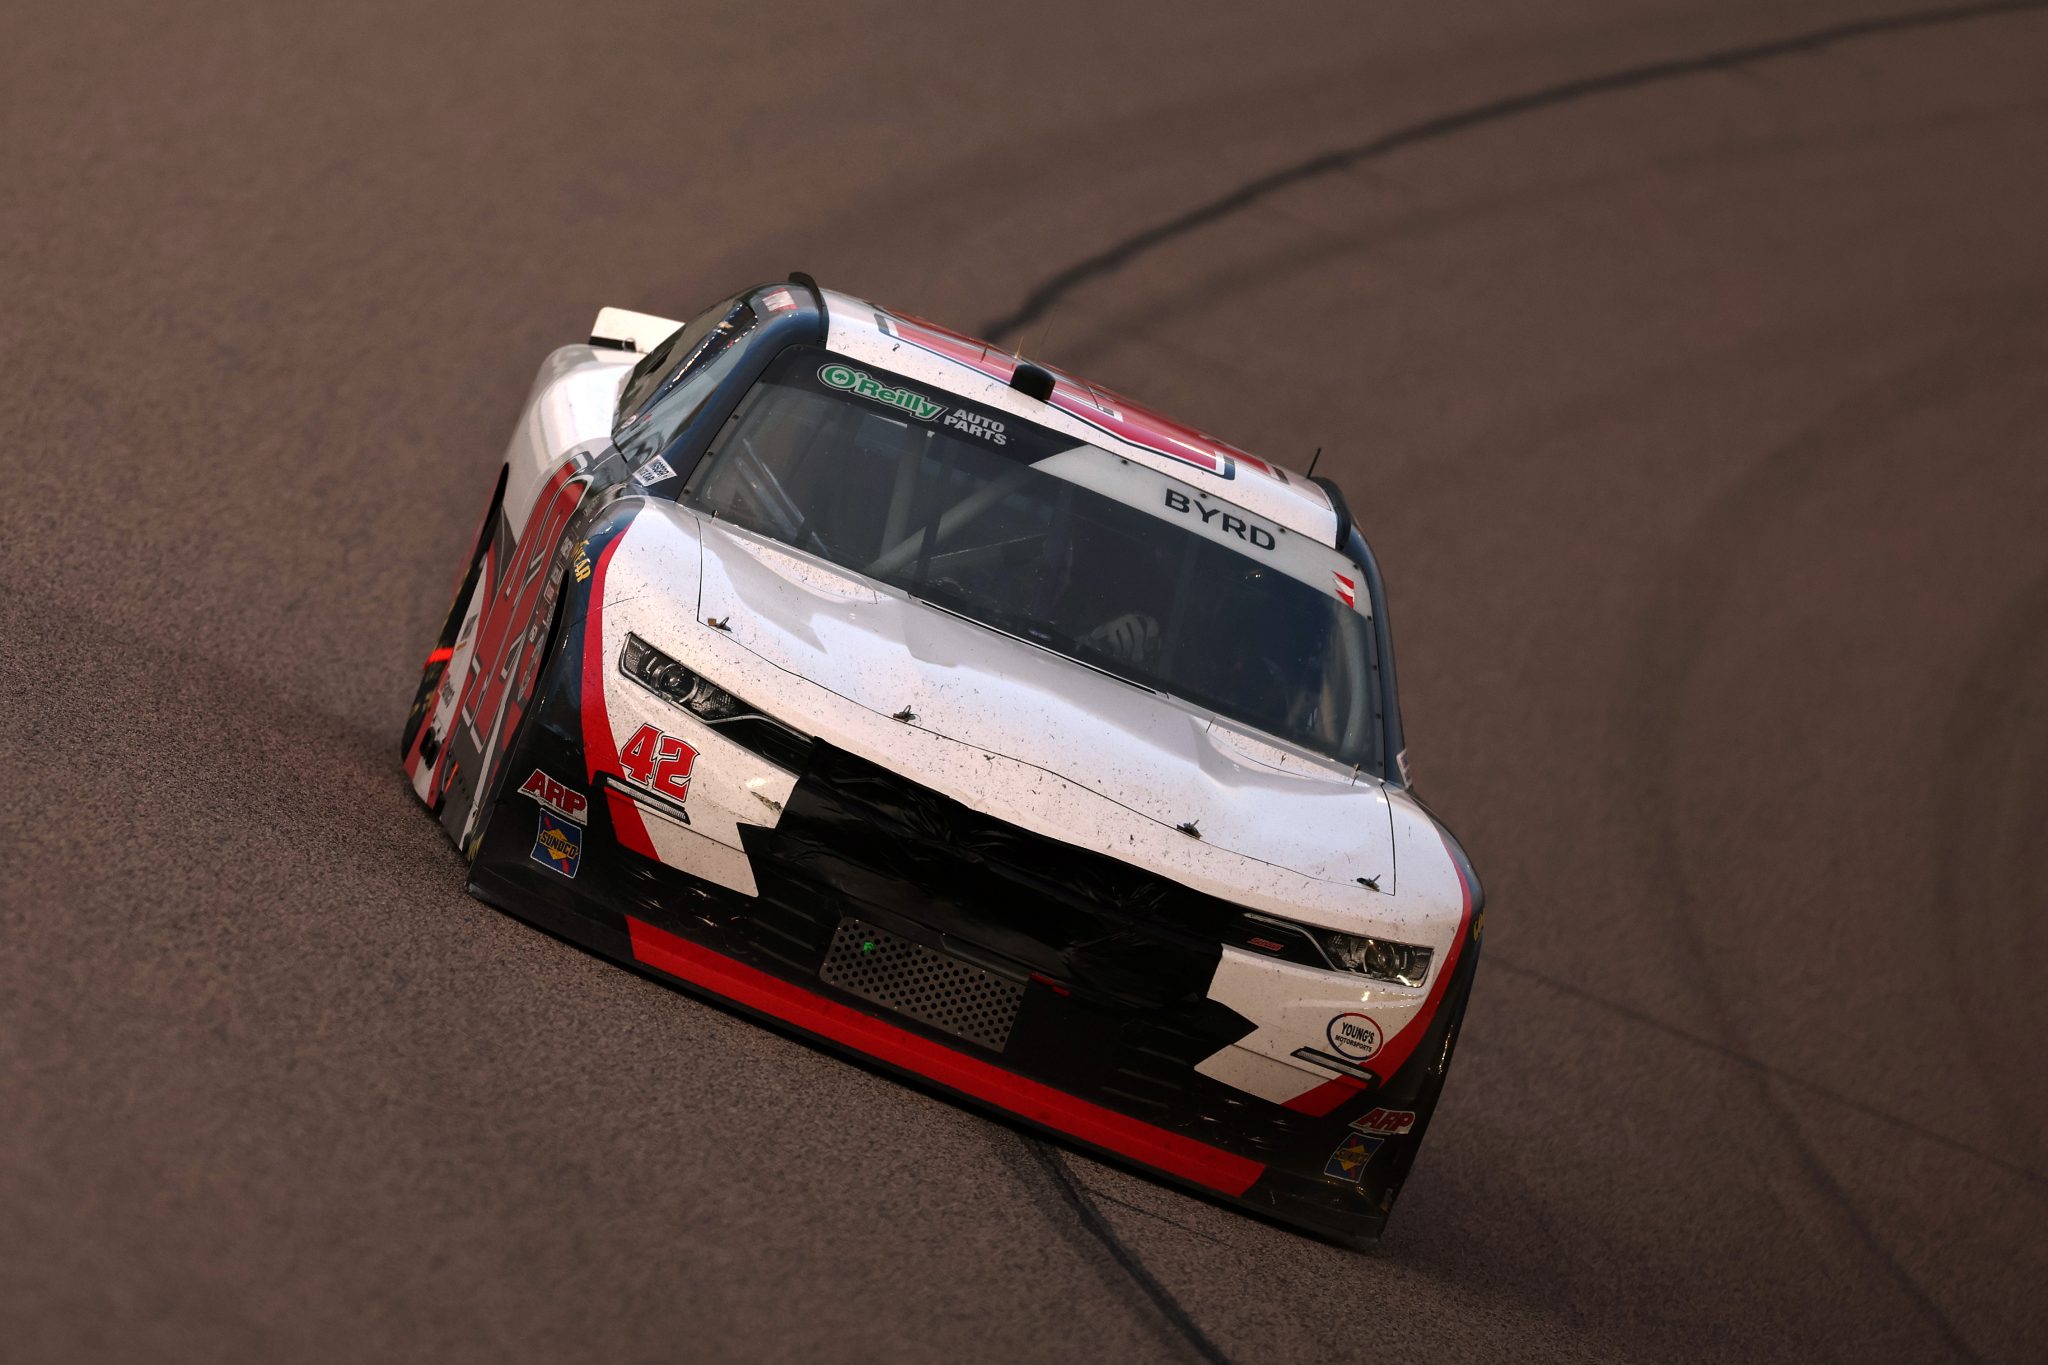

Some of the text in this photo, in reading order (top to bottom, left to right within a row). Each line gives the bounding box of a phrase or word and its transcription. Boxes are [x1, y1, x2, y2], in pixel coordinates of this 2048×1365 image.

[819, 364, 945, 419] O'Reilly
[943, 415, 1007, 446] PARTS
[953, 408, 1005, 433] AUTO
[1164, 488, 1276, 551] BYRD
[619, 722, 701, 803] 42
[522, 770, 587, 815] ARP
[541, 831, 578, 859] SUNOCO
[1335, 1034, 1372, 1052] MOTORSPORTS
[1341, 1022, 1374, 1044] YOUNG'S
[1356, 1108, 1414, 1131] ARP
